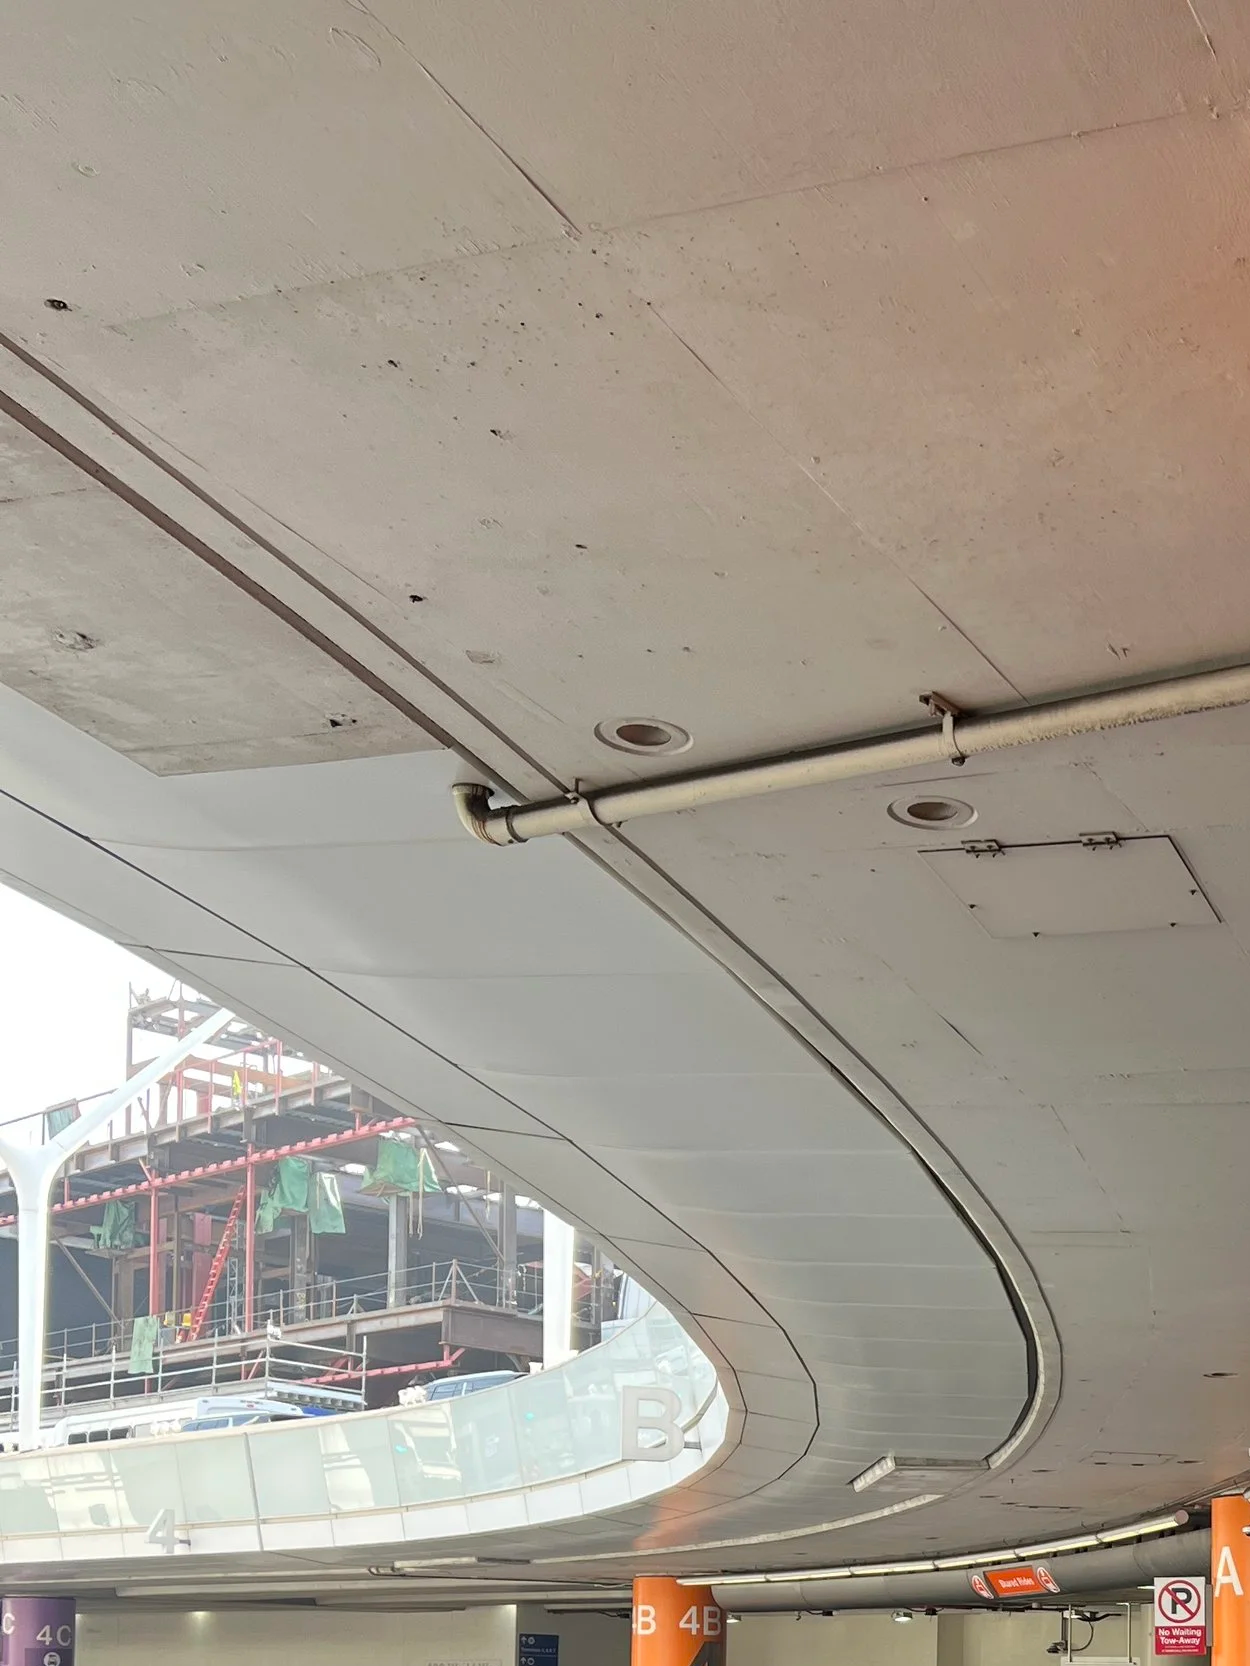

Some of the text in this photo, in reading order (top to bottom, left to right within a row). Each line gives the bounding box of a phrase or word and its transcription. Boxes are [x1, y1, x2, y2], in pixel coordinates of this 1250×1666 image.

[621, 1386, 686, 1462] B
[146, 1508, 178, 1554] 4
[1214, 1546, 1244, 1597] A
[36, 1624, 72, 1647] 4C
[679, 1605, 721, 1636] 4B
[1158, 1628, 1202, 1637] No Waiting
[1160, 1637, 1200, 1645] Tow-Away
